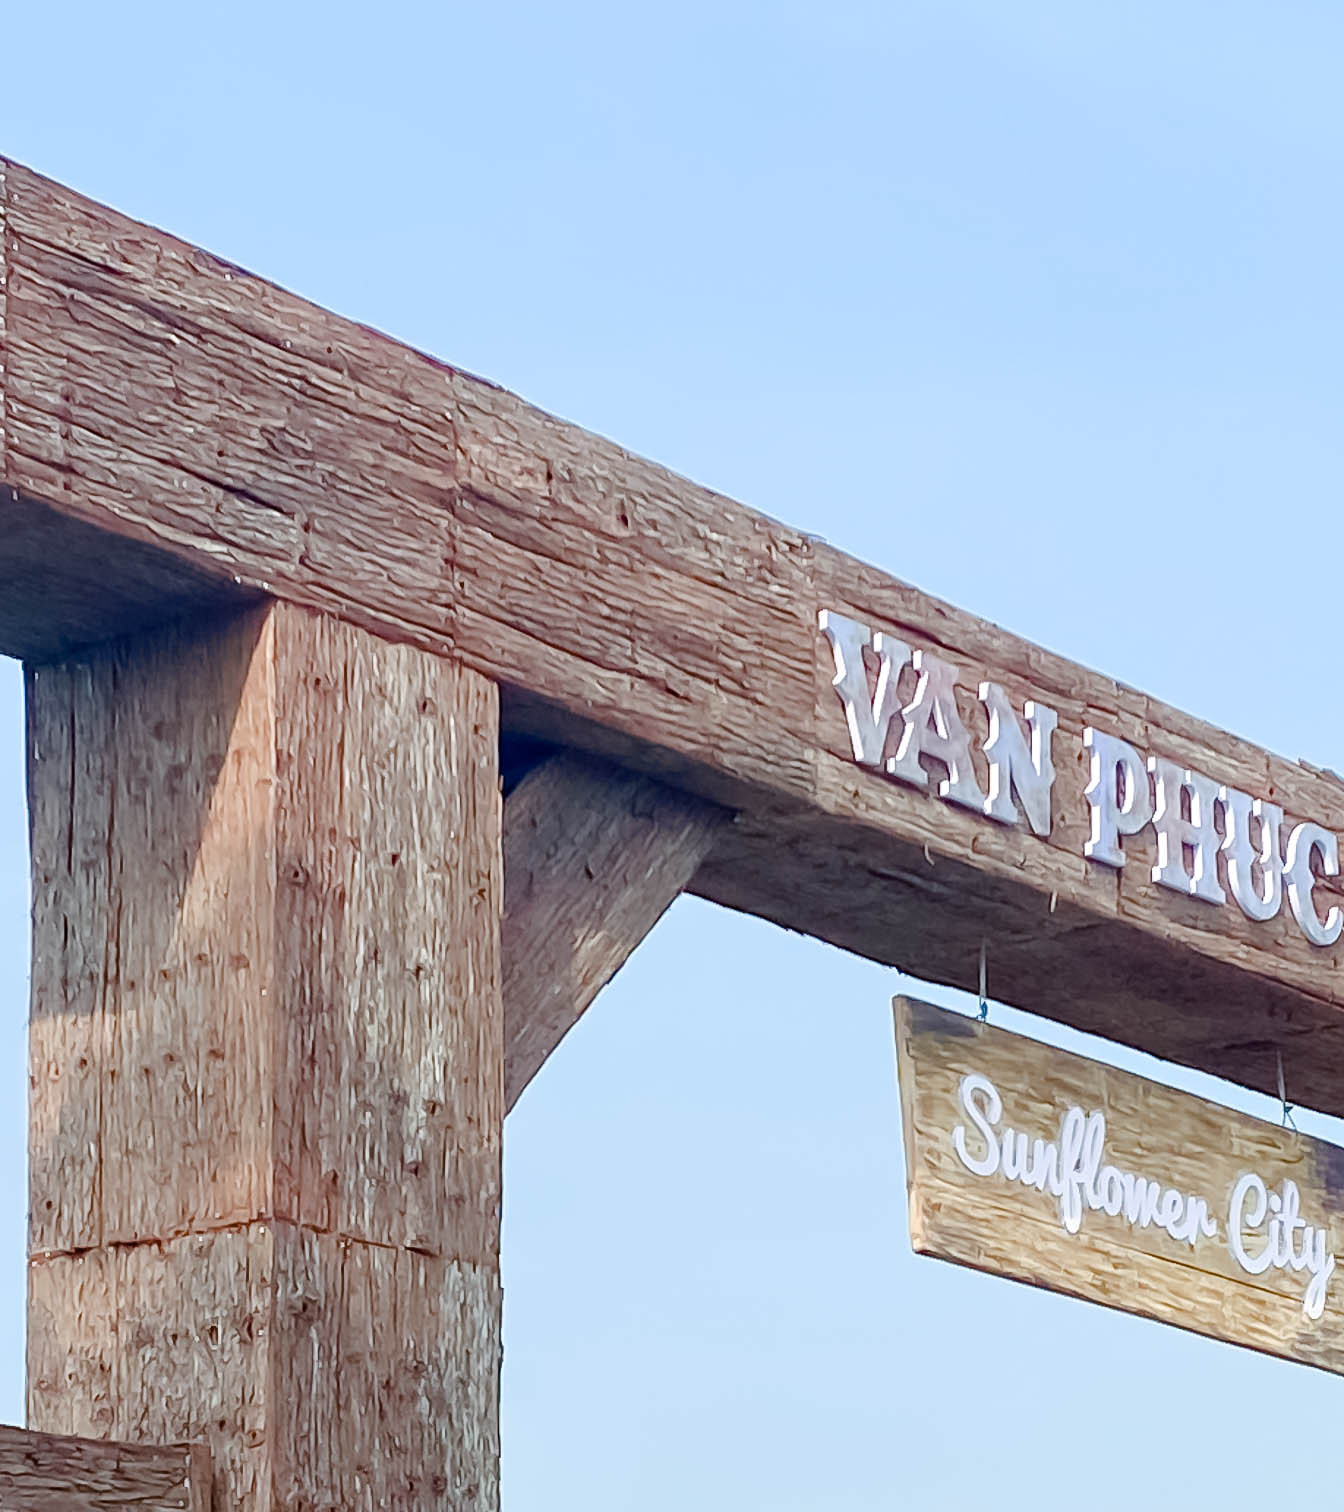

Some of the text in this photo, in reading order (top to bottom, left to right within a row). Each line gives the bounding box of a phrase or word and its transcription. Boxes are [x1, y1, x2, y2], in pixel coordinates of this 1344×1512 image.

[818, 608, 1059, 836] VAN
[1083, 726, 1344, 947] PHUC
[952, 1074, 1336, 1320] Sunflower City
